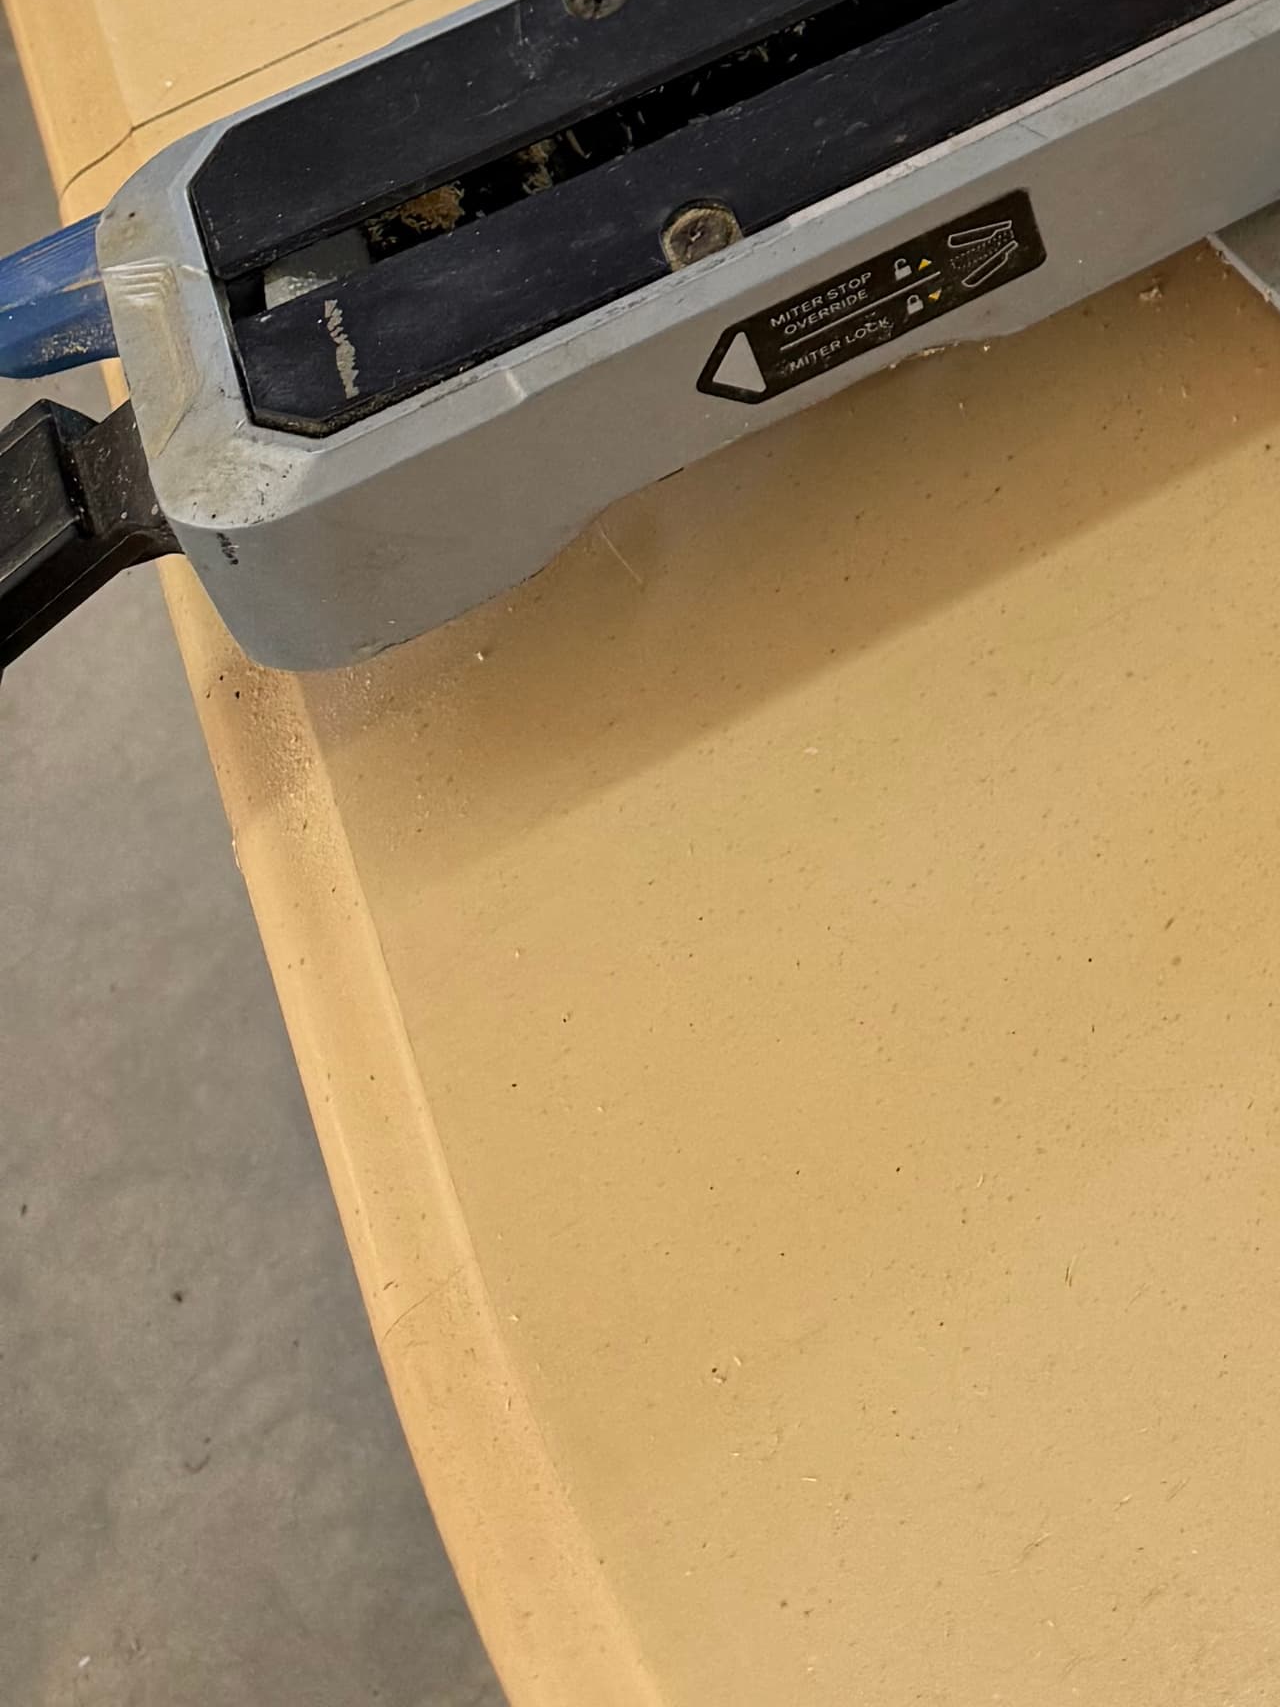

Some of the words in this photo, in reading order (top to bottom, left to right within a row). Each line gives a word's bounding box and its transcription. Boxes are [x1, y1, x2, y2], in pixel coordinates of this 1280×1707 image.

[770, 295, 824, 327] MITER
[827, 271, 872, 300] STOP
[784, 288, 869, 335] OVERRIDE
[787, 340, 841, 373] MITER
[845, 316, 891, 344] LOCK
